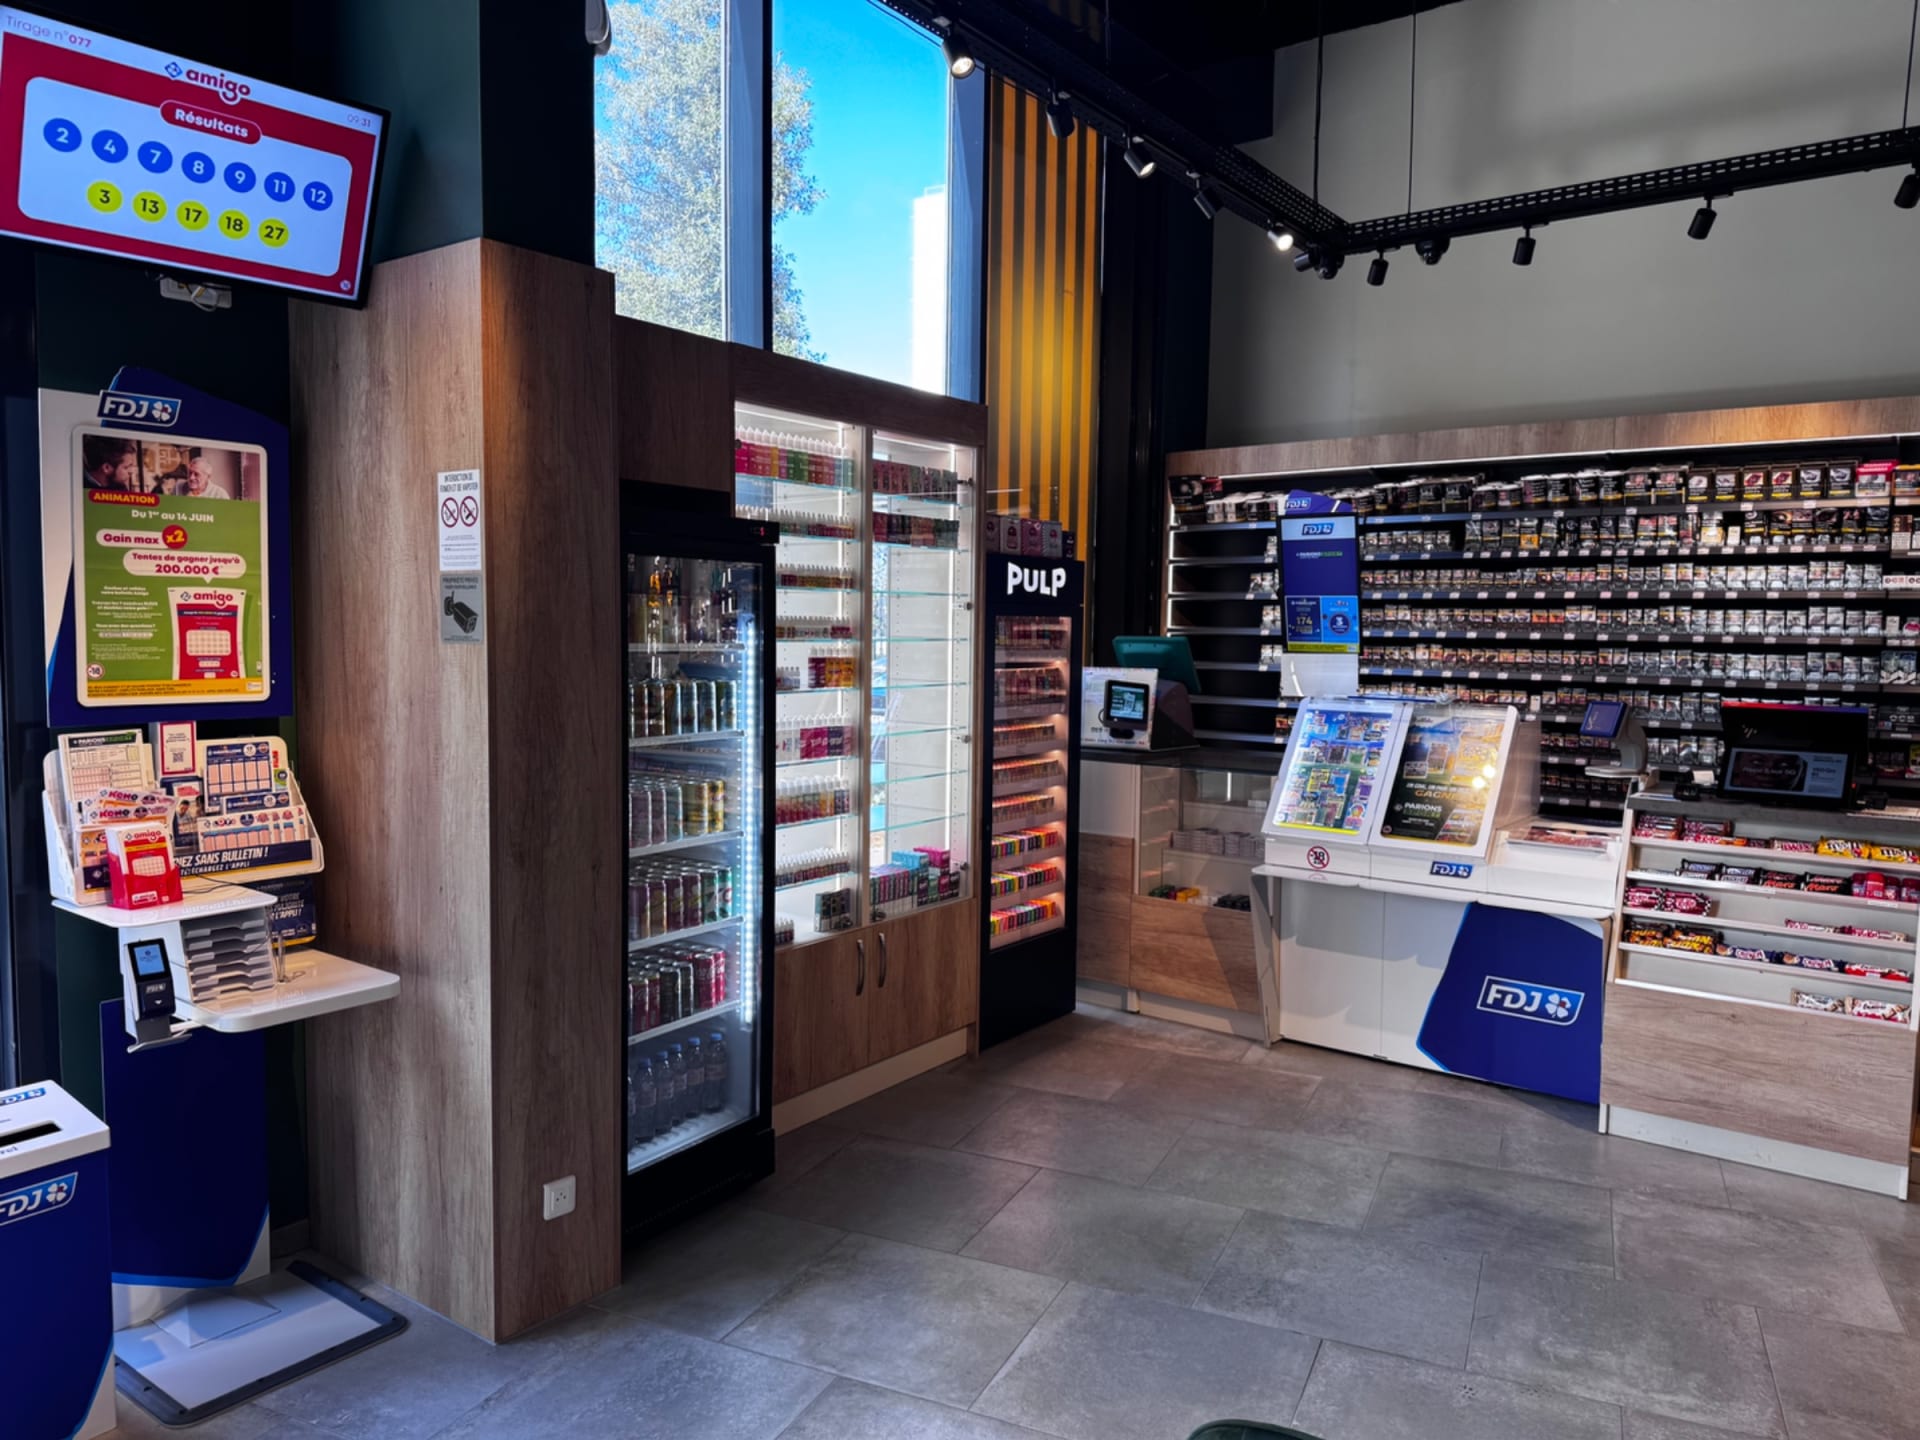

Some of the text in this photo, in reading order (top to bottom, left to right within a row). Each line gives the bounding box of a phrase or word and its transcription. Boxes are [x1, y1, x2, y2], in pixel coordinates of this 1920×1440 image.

[7, 15, 51, 37] Tirage
[186, 69, 251, 102] amigo
[175, 108, 249, 138] Résultats
[56, 128, 327, 204] 2 4 7 8 9 11 12
[99, 189, 284, 241] 3 13 17 18 27
[103, 396, 149, 418] FDJ
[93, 492, 156, 504] ANIMATION
[177, 513, 187, 521] 14
[188, 513, 214, 522] JUIN
[166, 530, 185, 544] x2
[1303, 525, 1321, 535] FDJ
[103, 533, 159, 544] Gain max
[132, 553, 162, 561] Tentez
[177, 555, 208, 564] gagner
[155, 564, 219, 575] 200.000 €
[1007, 561, 1066, 597] PULP
[193, 590, 233, 607] amigo
[1404, 802, 1442, 812] PARIONS
[134, 830, 161, 841] amigo
[194, 853, 220, 867] SANS
[221, 848, 263, 863] BULLETIN
[264, 846, 269, 857] !
[1433, 863, 1456, 875] FDJ
[1486, 984, 1542, 1012] FDJ
